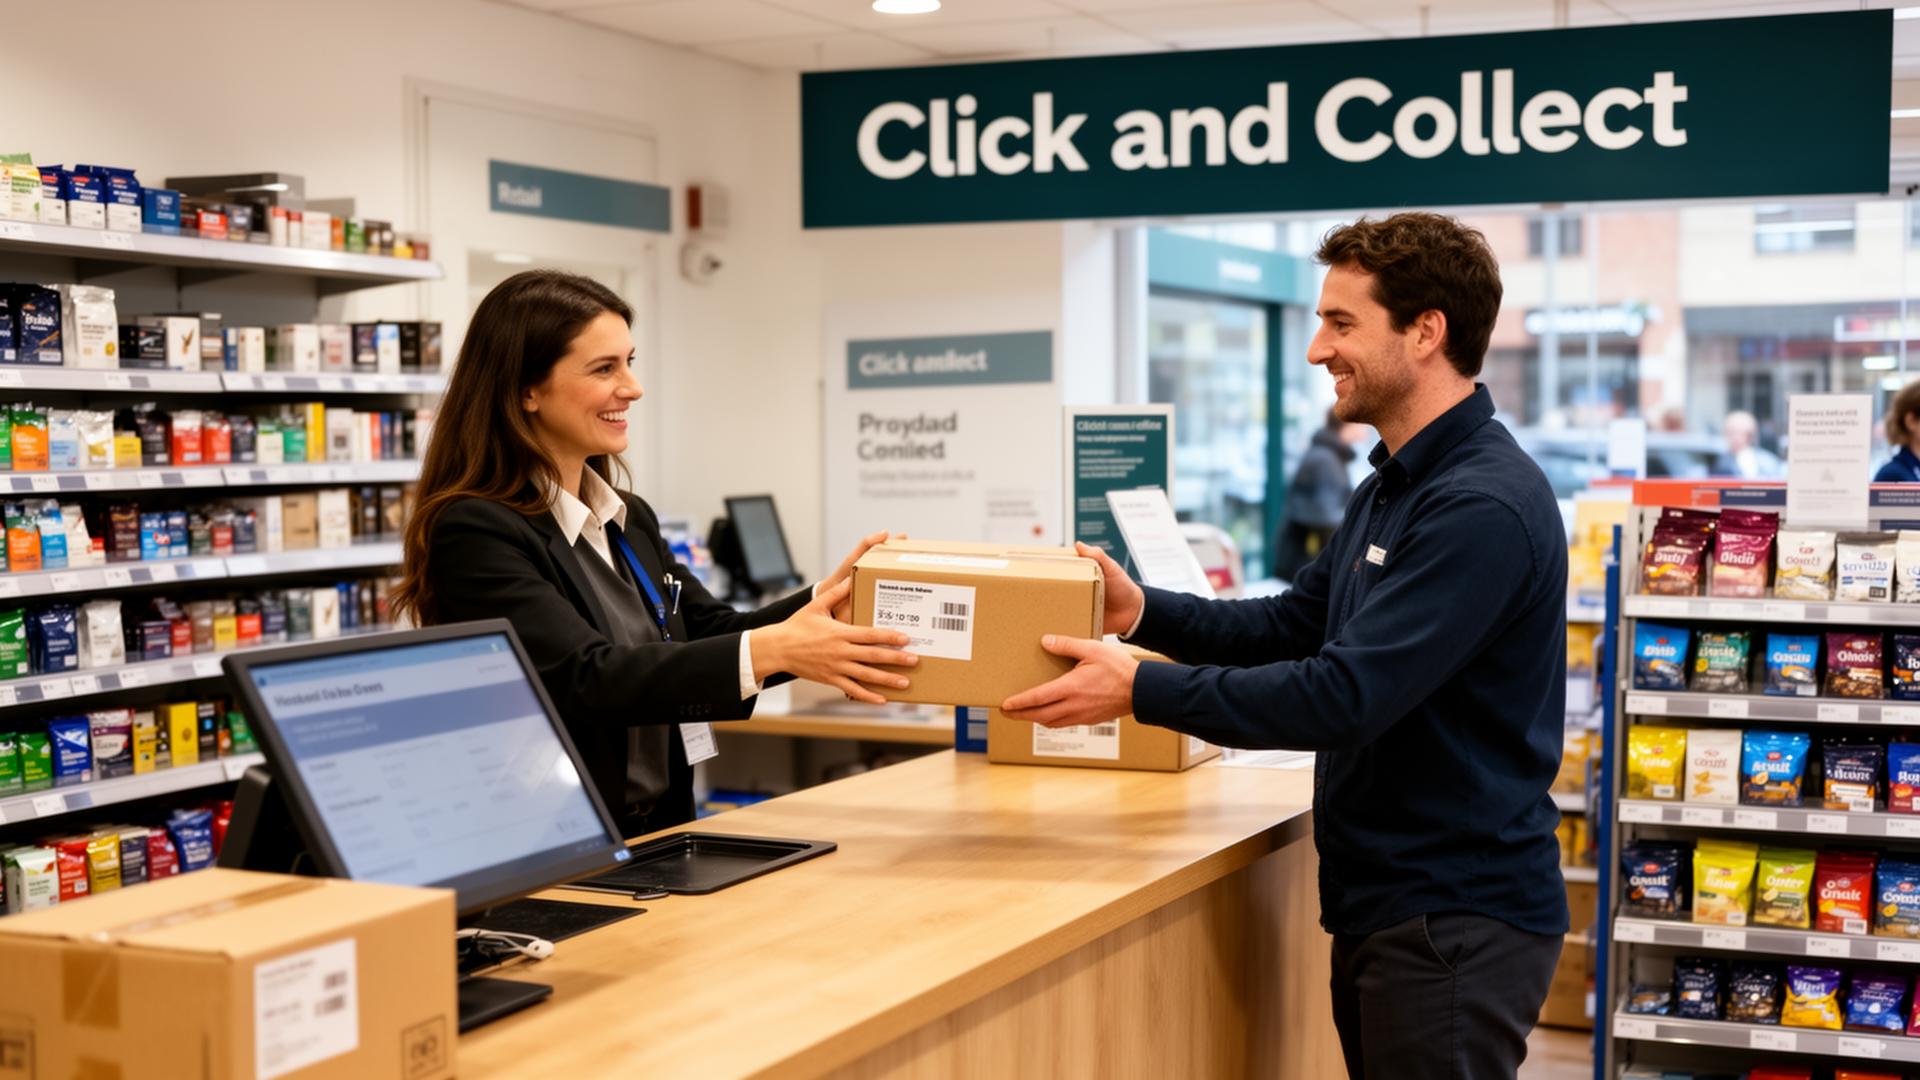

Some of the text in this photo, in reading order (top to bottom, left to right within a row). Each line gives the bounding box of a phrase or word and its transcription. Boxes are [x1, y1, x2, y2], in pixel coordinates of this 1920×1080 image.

[856, 68, 1689, 180] Click and Collect
